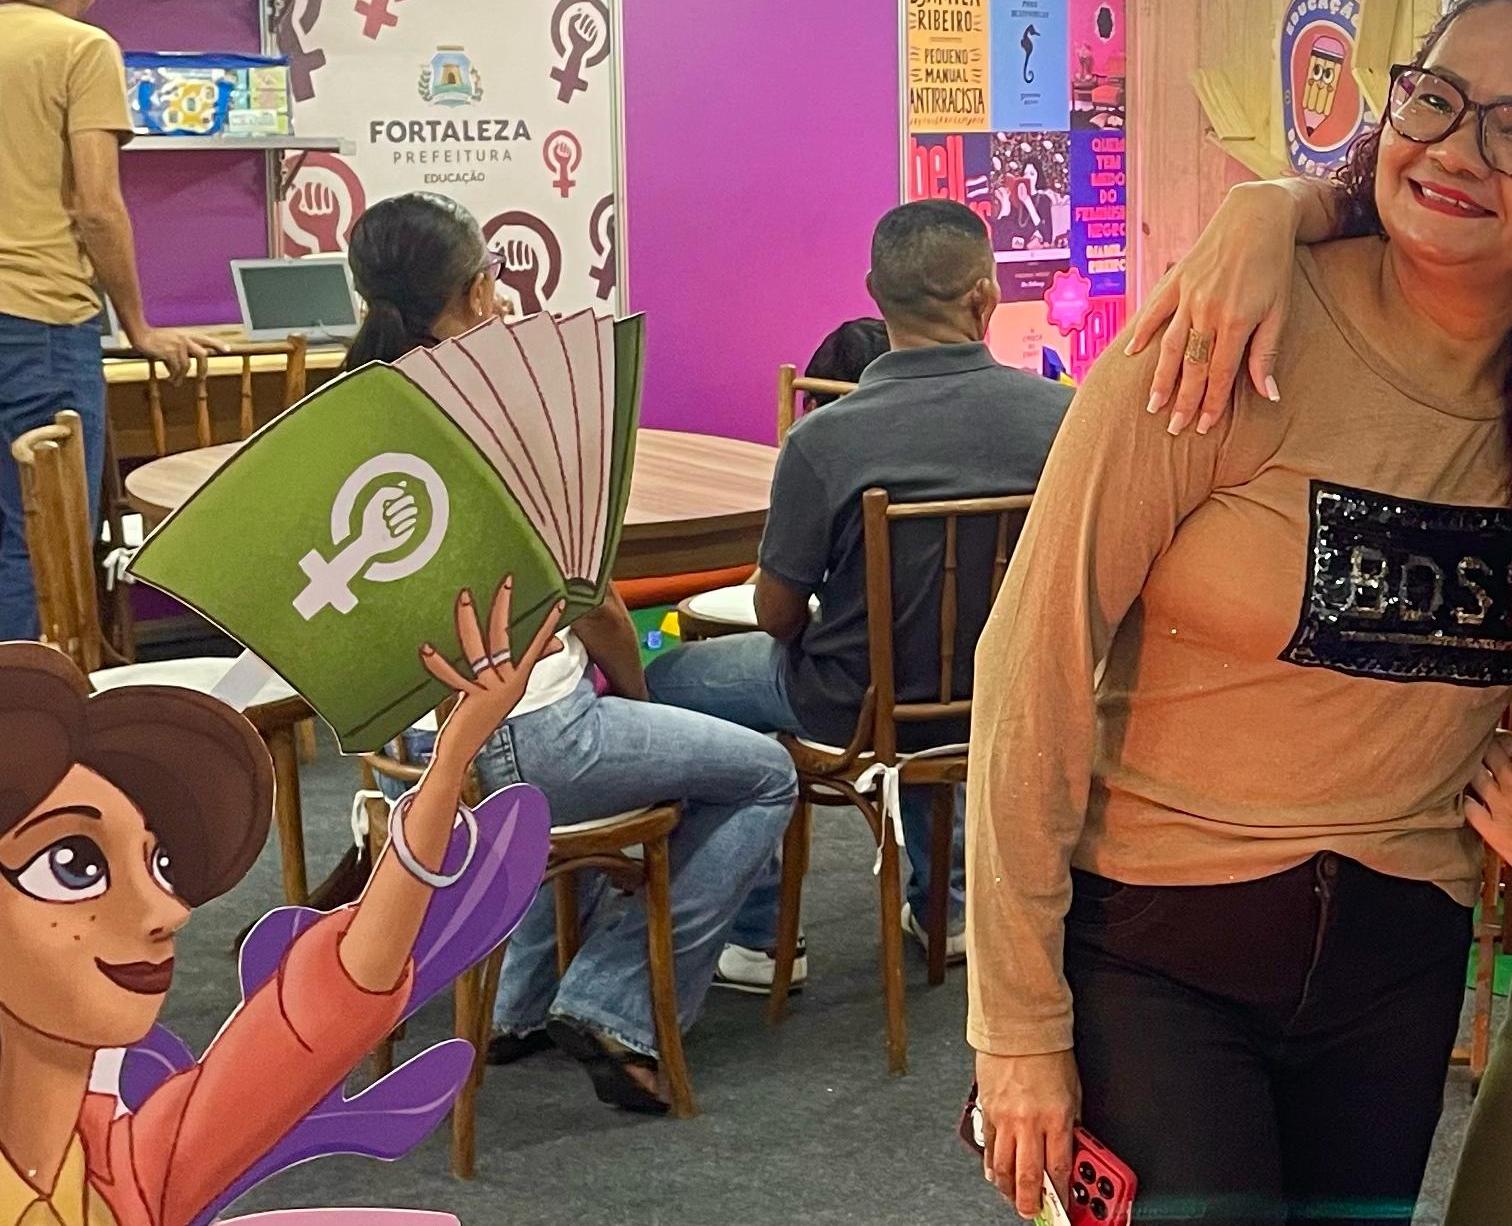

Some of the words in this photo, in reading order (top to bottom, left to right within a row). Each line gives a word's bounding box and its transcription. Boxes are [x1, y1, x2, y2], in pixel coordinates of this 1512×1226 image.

[918, 9, 973, 33] RIBEIRO
[924, 47, 969, 65] PEQUENO
[924, 67, 969, 83] MANUAL
[910, 87, 985, 114] ANTIRRACISTA
[370, 120, 531, 143] FORTALEZA
[393, 149, 512, 165] PREFEITURA
[424, 170, 485, 184] EDUCAÇÃO
[910, 135, 966, 203] bell
[1099, 188, 1118, 204] DO
